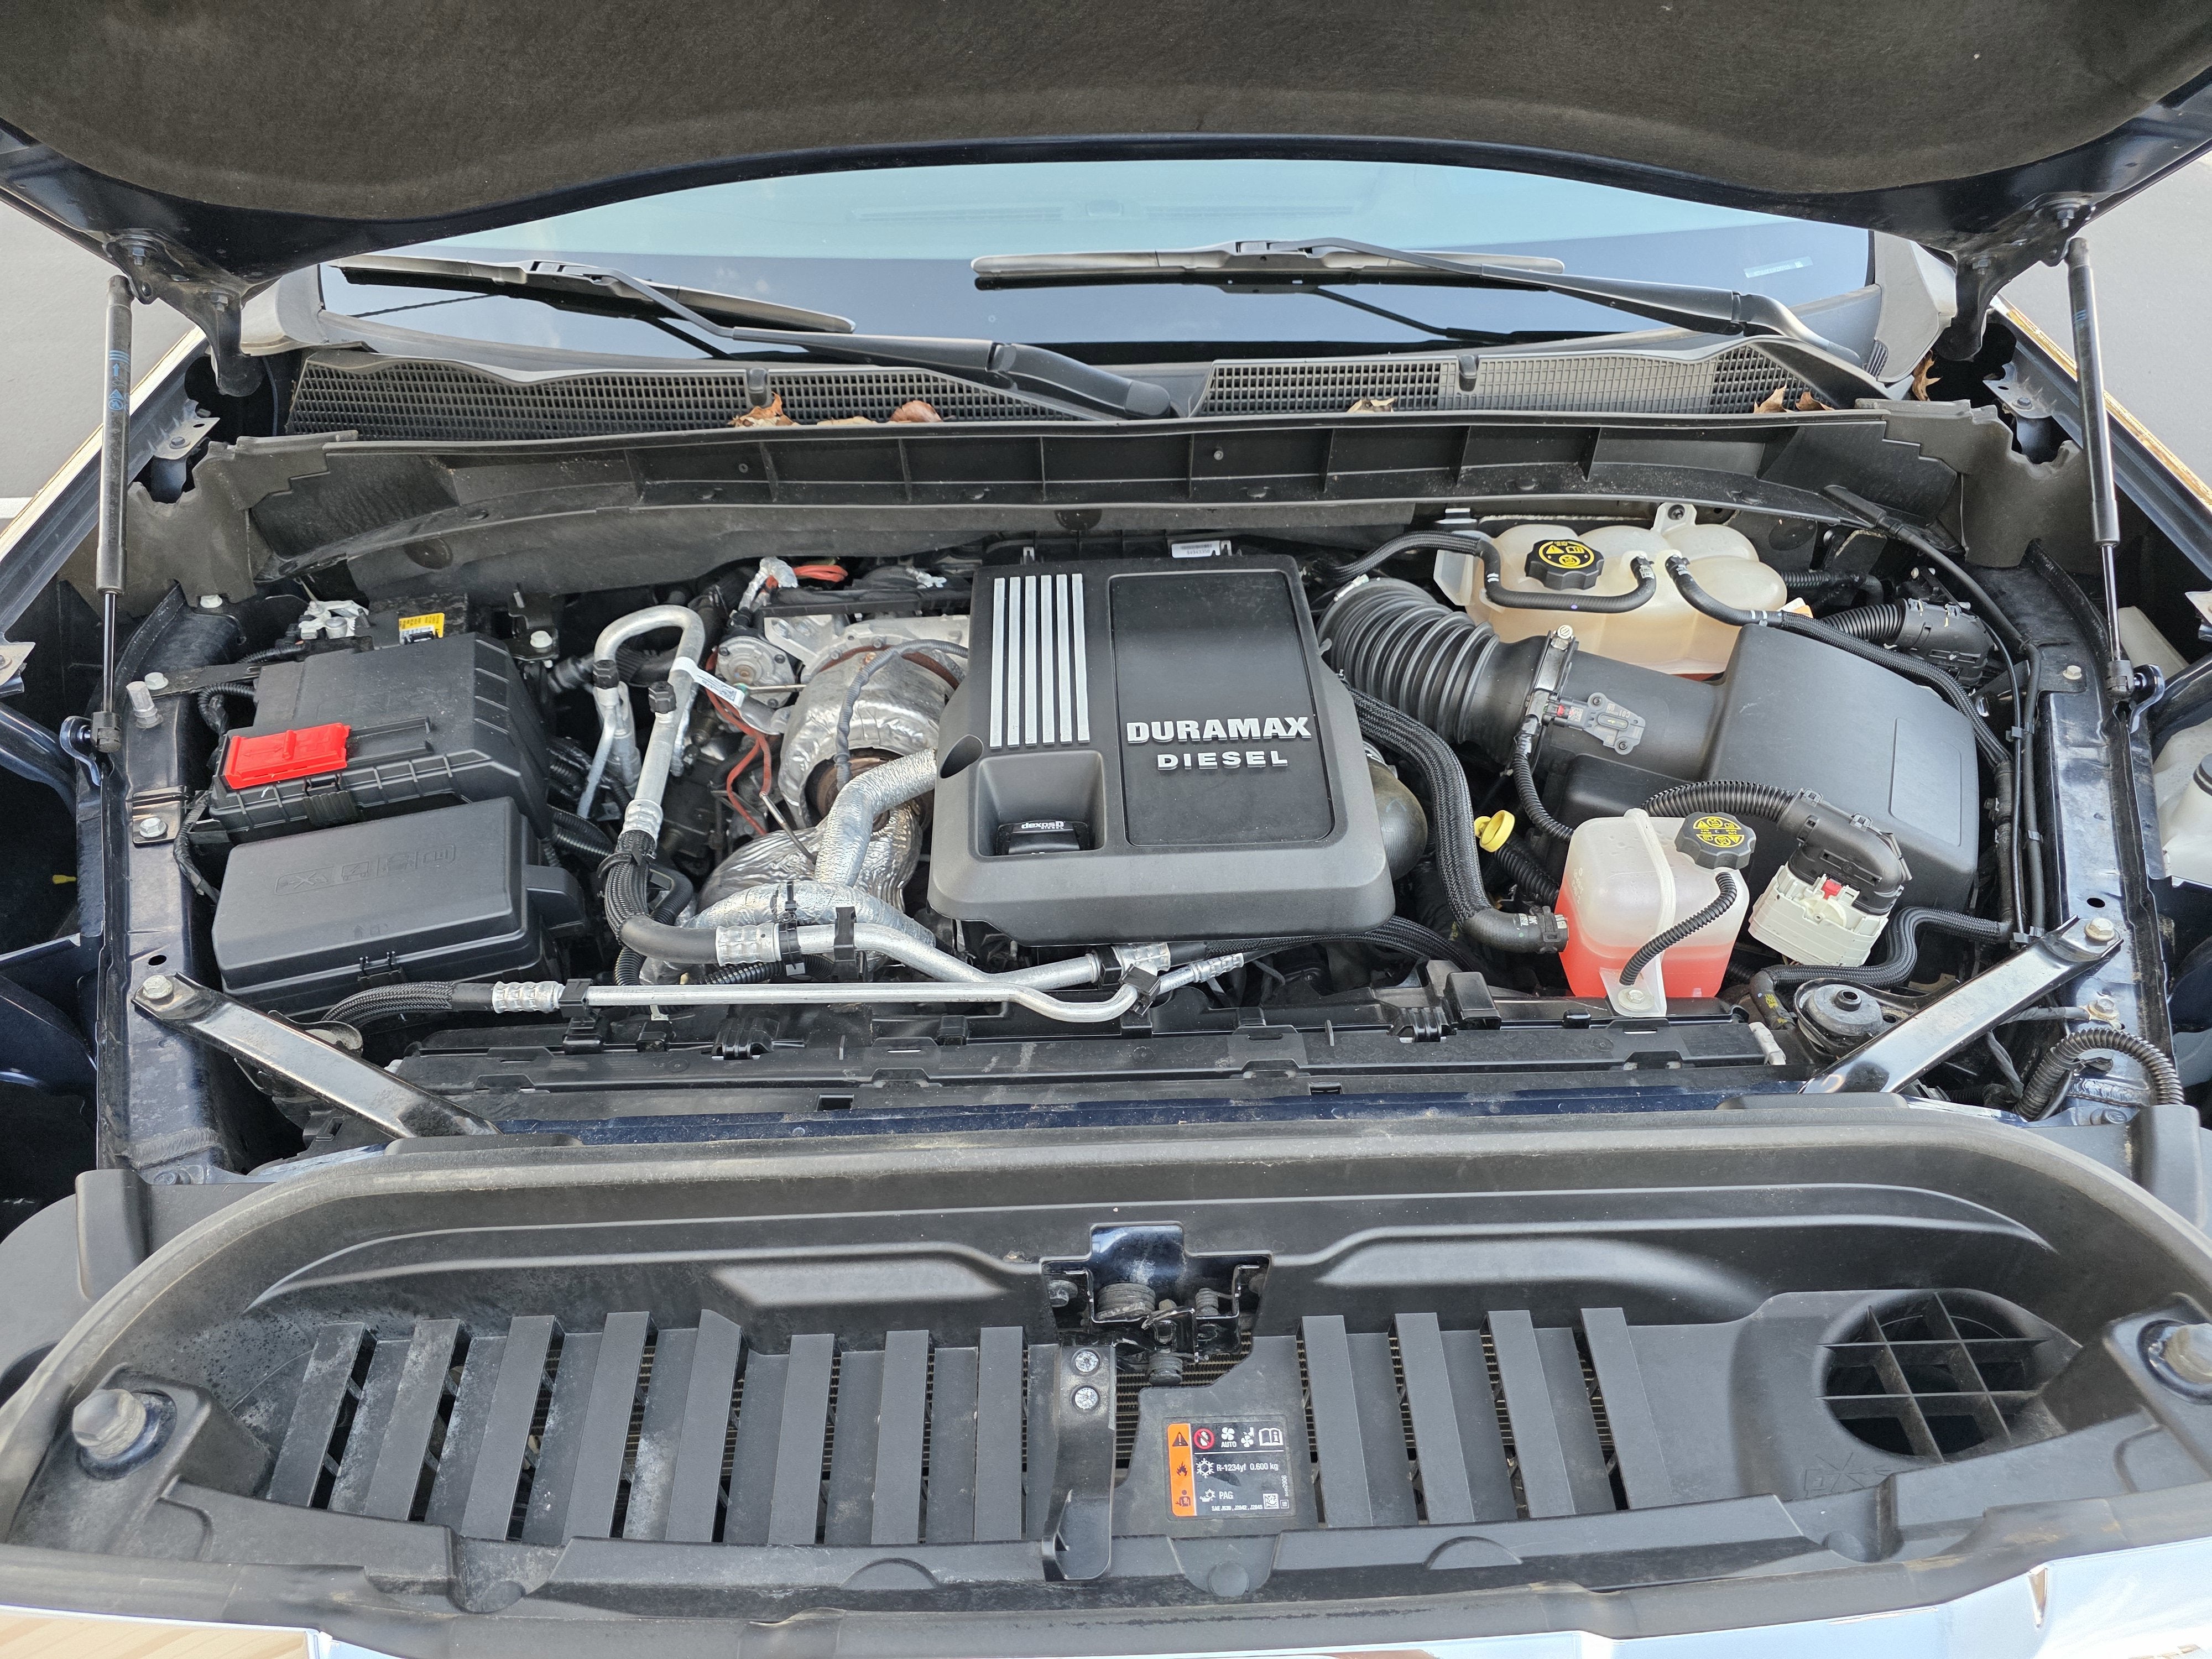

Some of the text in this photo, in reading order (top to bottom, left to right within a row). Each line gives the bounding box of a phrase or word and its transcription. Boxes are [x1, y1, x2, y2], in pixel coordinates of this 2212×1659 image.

[1127, 717, 1312, 744] DURAMAX
[1157, 751, 1288, 770] DIESEL
[1217, 1463, 1246, 1472] R-1234yf
[1270, 1463, 1279, 1471] kg
